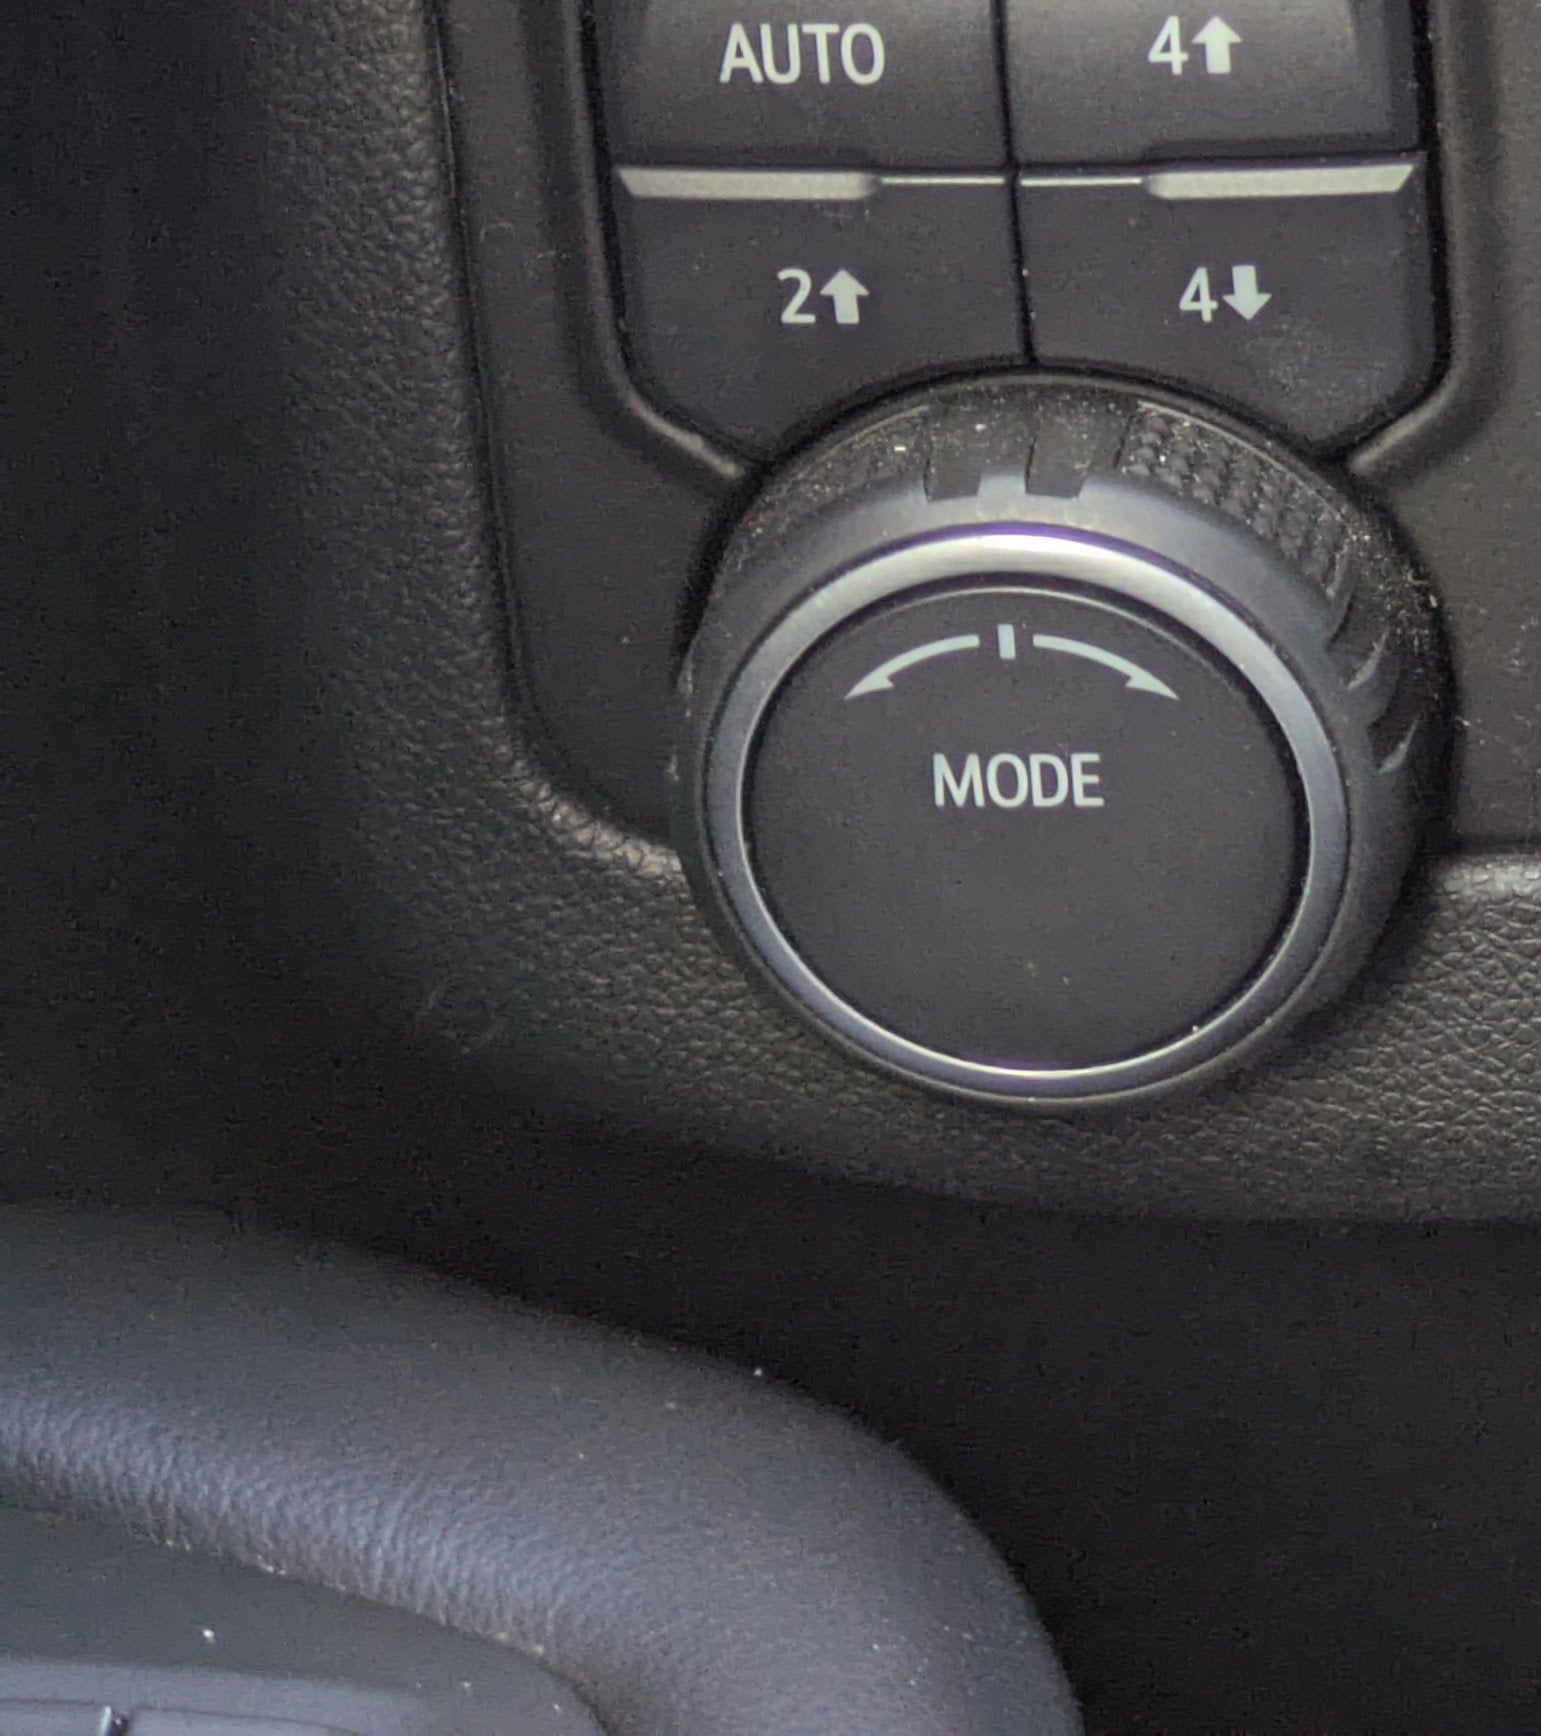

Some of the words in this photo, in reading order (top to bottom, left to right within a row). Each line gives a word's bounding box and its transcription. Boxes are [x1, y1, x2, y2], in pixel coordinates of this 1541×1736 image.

[720, 21, 885, 84] AUTO
[1148, 15, 1188, 75] 4
[777, 268, 816, 324] 2
[1179, 267, 1218, 322] 4
[933, 753, 1105, 809] MODE
